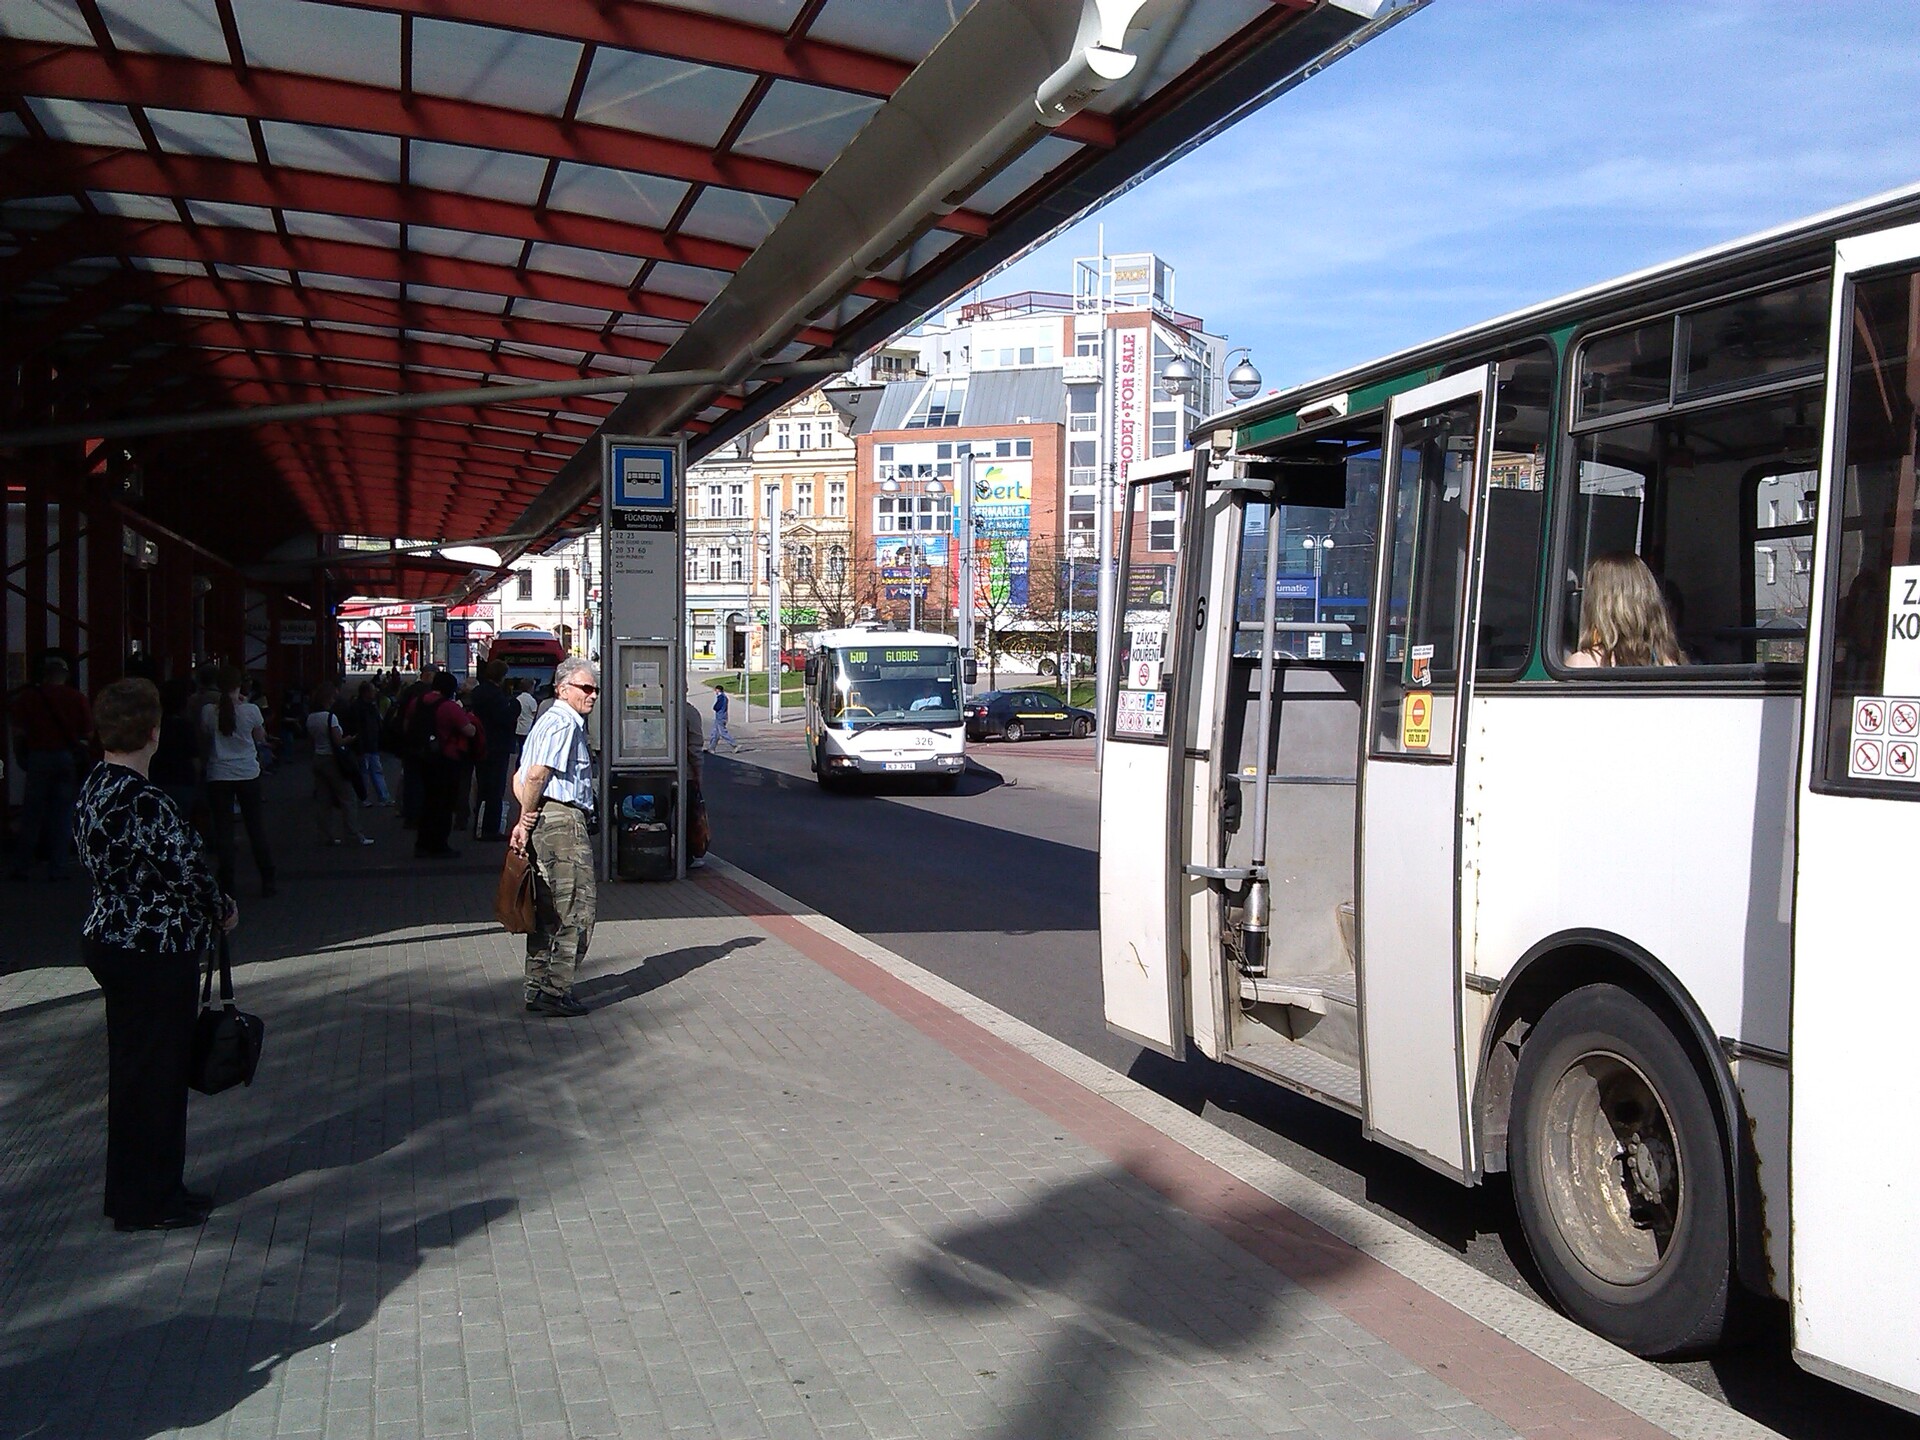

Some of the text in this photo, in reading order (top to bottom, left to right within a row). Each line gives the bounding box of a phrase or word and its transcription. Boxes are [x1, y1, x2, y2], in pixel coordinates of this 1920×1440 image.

[1122, 334, 1136, 373] SALE
[1122, 377, 1134, 411] FOR
[615, 546, 624, 554] 20
[1276, 583, 1308, 592] umatic
[1903, 579, 1920, 605] Z
[1195, 596, 1206, 631] 6
[1892, 613, 1920, 640] KO
[1135, 628, 1158, 645] ZÁKAZ
[885, 650, 919, 662] GLOBUS
[1132, 645, 1160, 662] KOUŘENÍ
[915, 737, 934, 746] 326
